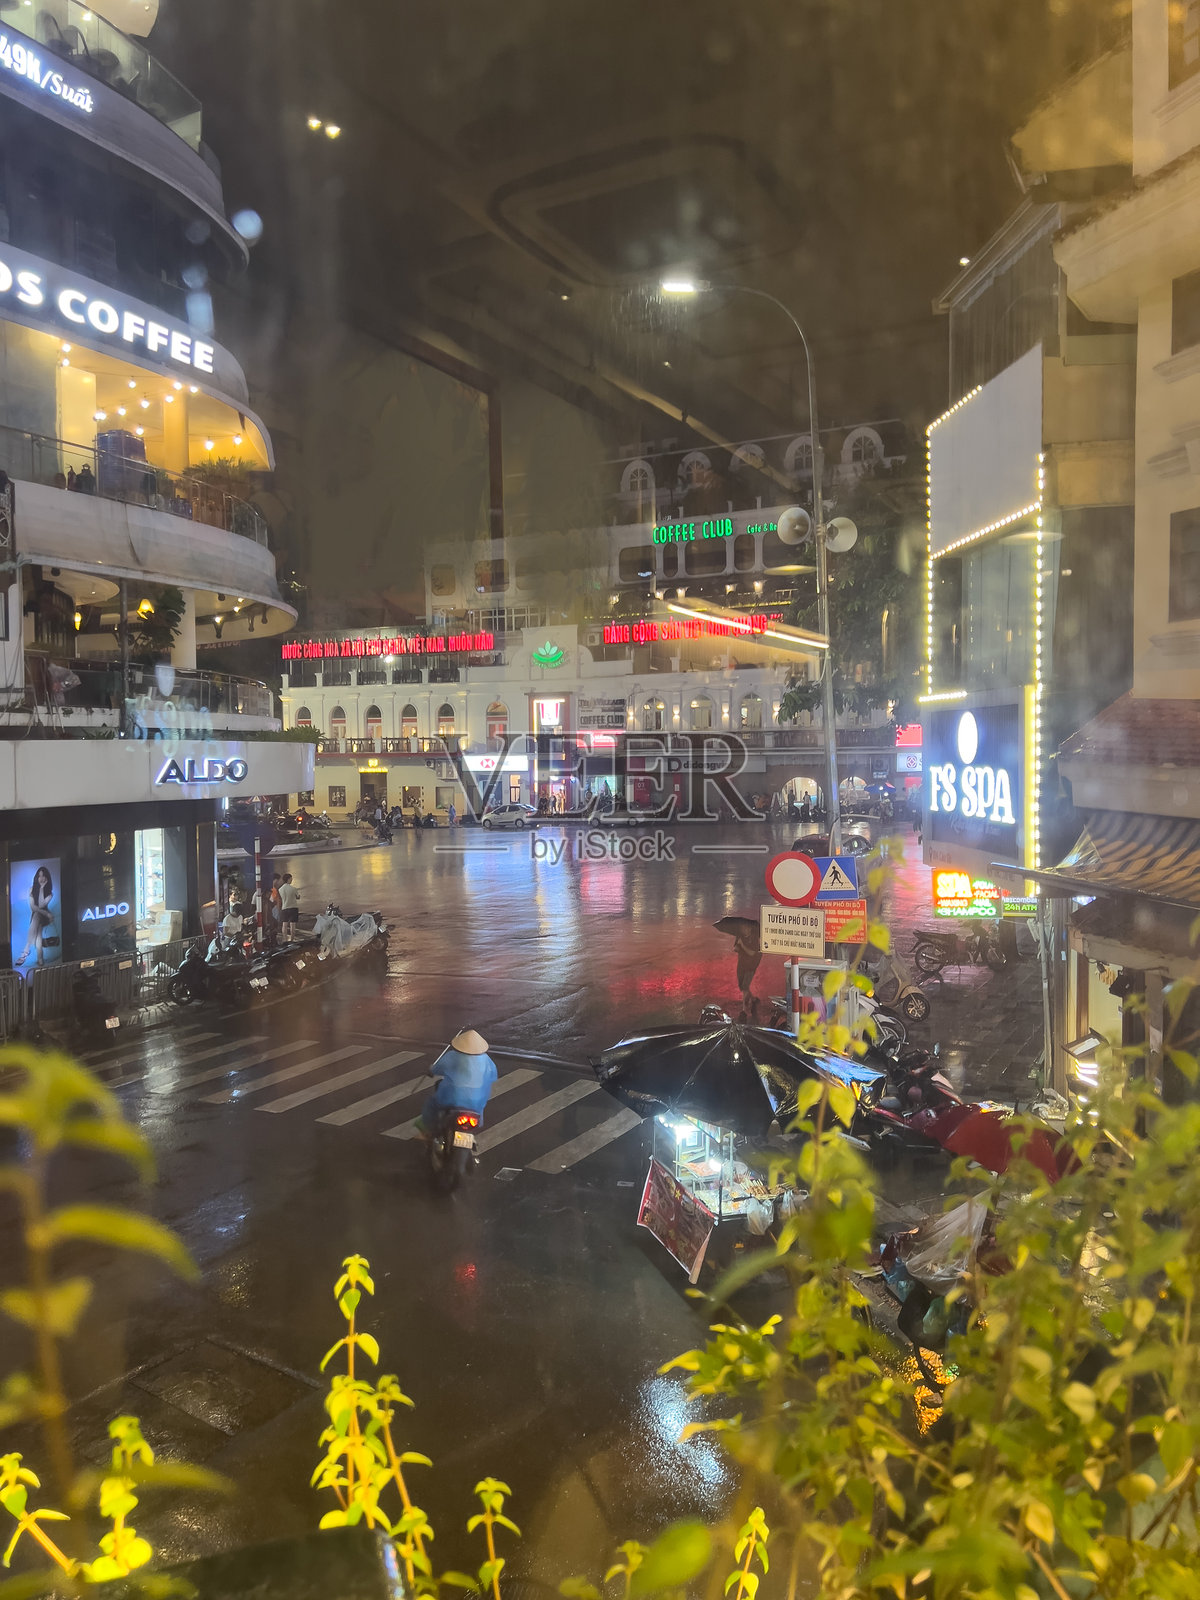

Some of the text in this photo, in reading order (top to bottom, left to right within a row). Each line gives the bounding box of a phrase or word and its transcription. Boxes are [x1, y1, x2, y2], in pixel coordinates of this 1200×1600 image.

[58, 289, 214, 373] COFFEE
[652, 523, 695, 544] COFFEE
[702, 518, 733, 539] CLUB
[769, 522, 777, 531] Re
[448, 631, 472, 651] MUÔN
[474, 629, 494, 650] NĂM
[631, 619, 659, 645] CỘNG
[156, 758, 248, 786] ALDO
[929, 764, 1016, 824] FS SPA
[82, 902, 130, 922] ALDO
[768, 912, 787, 924] TUYẾN
[788, 913, 801, 925] PHỐ
